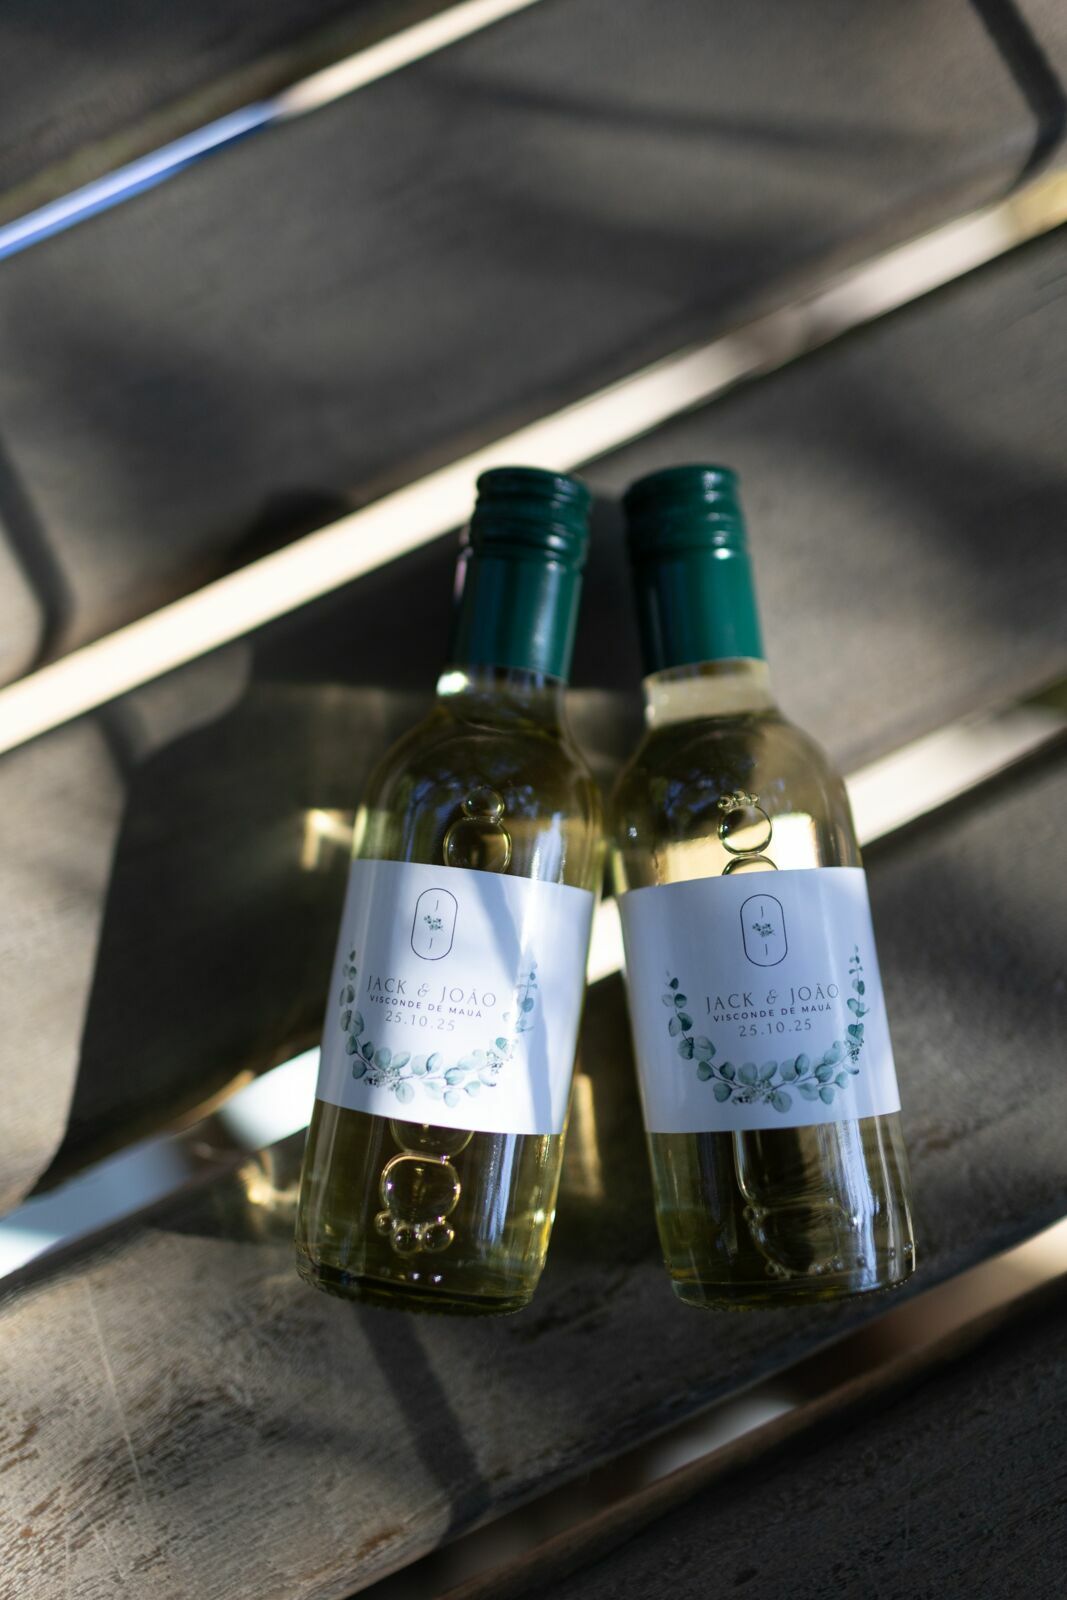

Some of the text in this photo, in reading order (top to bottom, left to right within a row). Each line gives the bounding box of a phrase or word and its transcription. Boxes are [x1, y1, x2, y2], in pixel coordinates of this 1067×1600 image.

[366, 975, 407, 995] JACK
[417, 982, 430, 998] &
[369, 994, 421, 1009] VISCONDE
[427, 1003, 442, 1013] DE
[705, 982, 839, 1015] JACK & JOÃO
[384, 1010, 456, 1032] 25.10.25
[713, 1009, 775, 1022] VISCONDE
[780, 1006, 796, 1016] DE
[739, 1018, 812, 1037] 25.10.25
